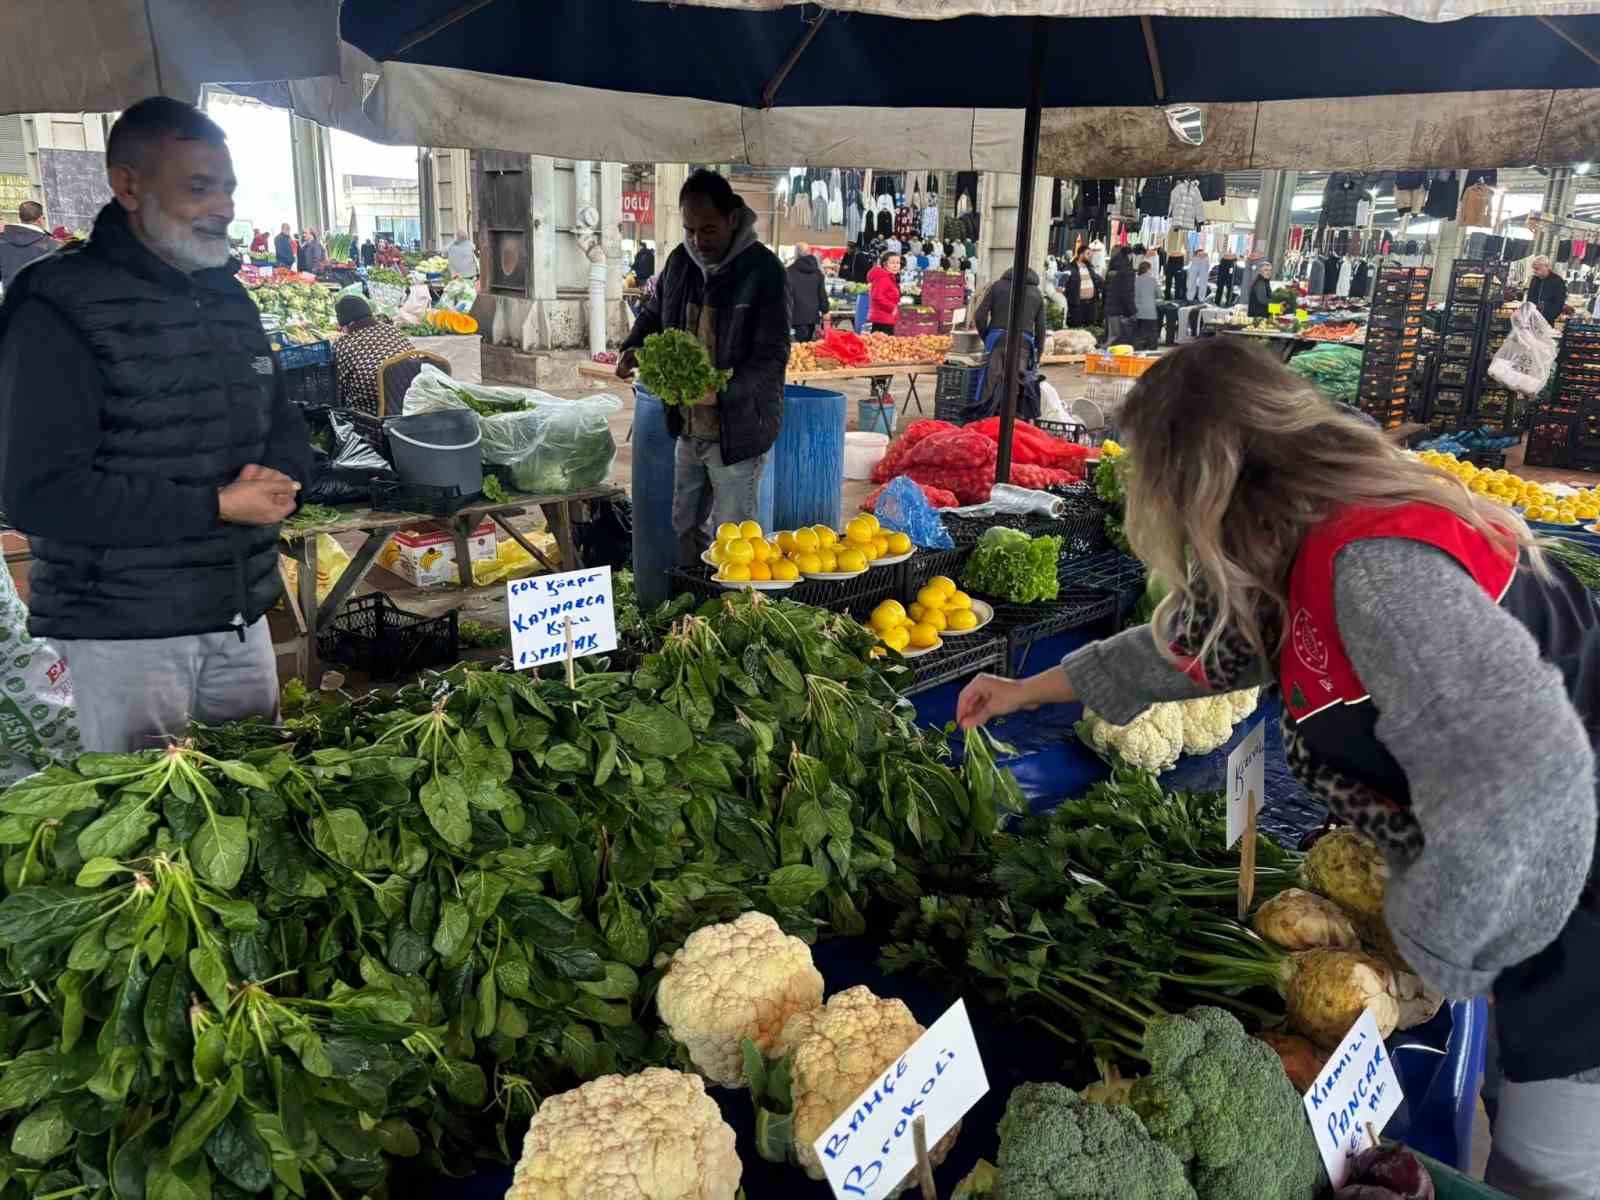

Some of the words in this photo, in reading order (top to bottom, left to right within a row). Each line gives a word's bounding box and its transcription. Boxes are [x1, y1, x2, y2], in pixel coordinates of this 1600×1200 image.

[512, 594, 605, 633] KAYNARCA
[824, 1055, 908, 1159] BAHÇE
[1311, 1032, 1366, 1109] KIRMIZI
[1328, 1045, 1385, 1149] PANCAR
